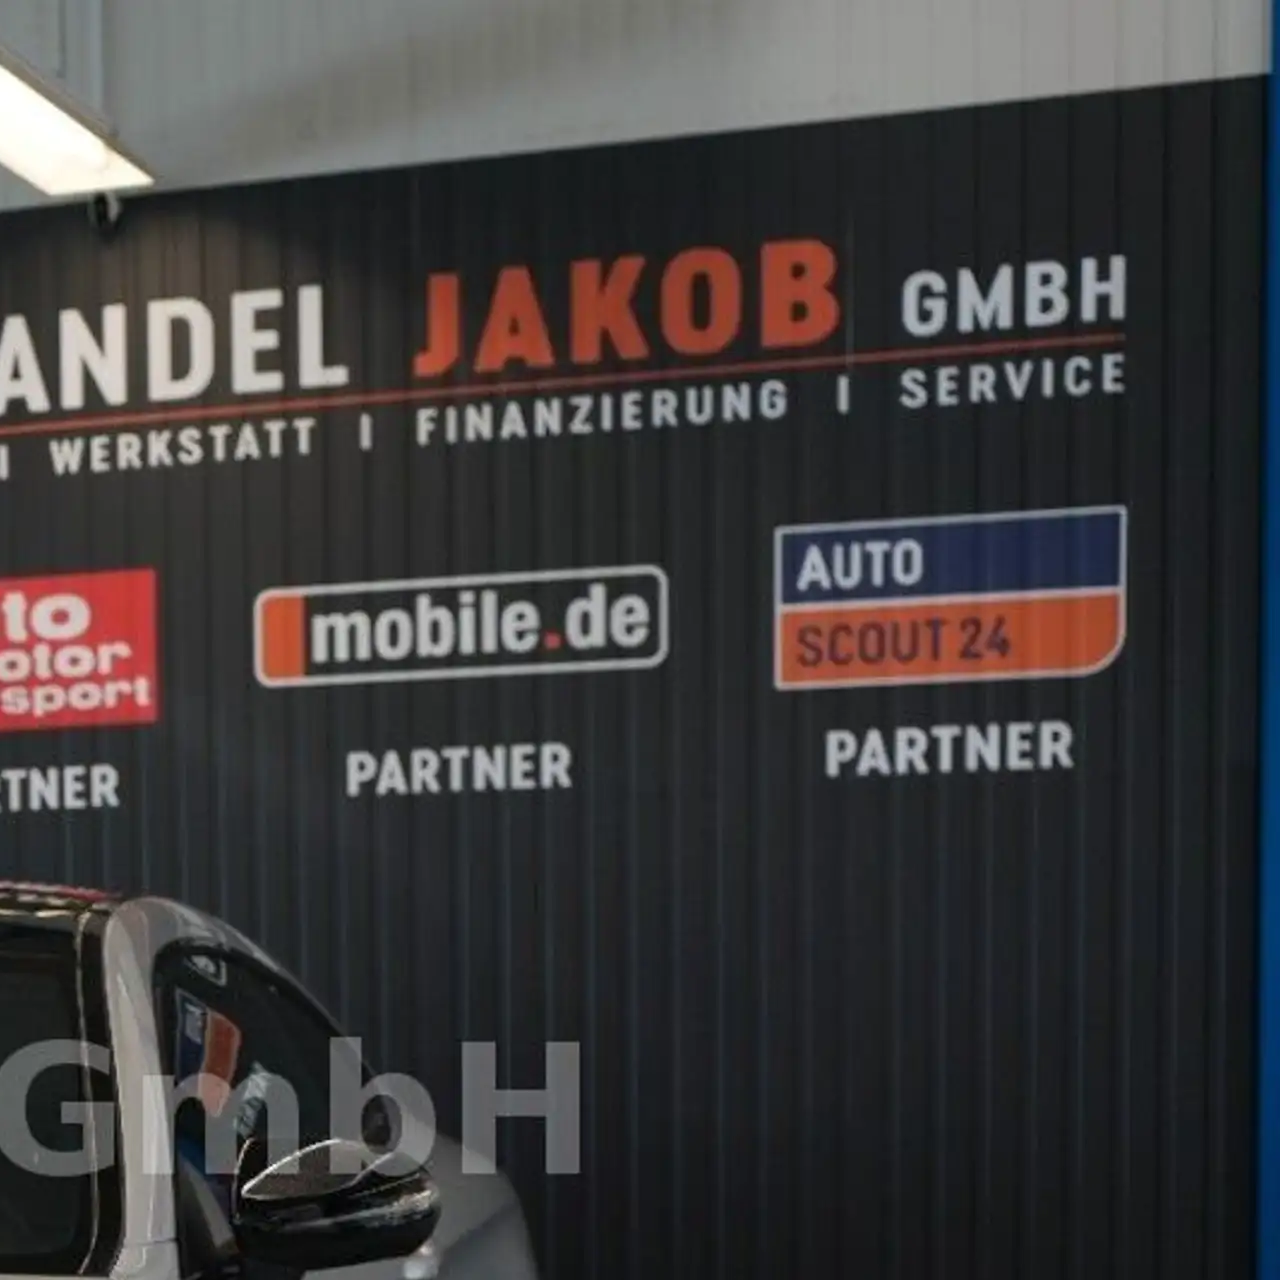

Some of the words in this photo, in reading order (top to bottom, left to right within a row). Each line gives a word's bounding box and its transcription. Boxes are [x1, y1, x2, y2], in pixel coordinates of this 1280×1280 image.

[413, 239, 840, 377] JAKOB
[901, 255, 1127, 338] GMBH
[50, 417, 317, 476] WERKSTATT
[416, 380, 789, 447] FINANZIERUNG
[901, 353, 1126, 408] SERVICE
[796, 540, 924, 592] AUTO
[312, 583, 650, 666] mobile.de
[796, 618, 945, 671] SCOUT
[958, 612, 1011, 660] 24
[0, 676, 151, 718] sport
[345, 742, 572, 798] PARTNER
[826, 721, 1074, 778] PARTNER
